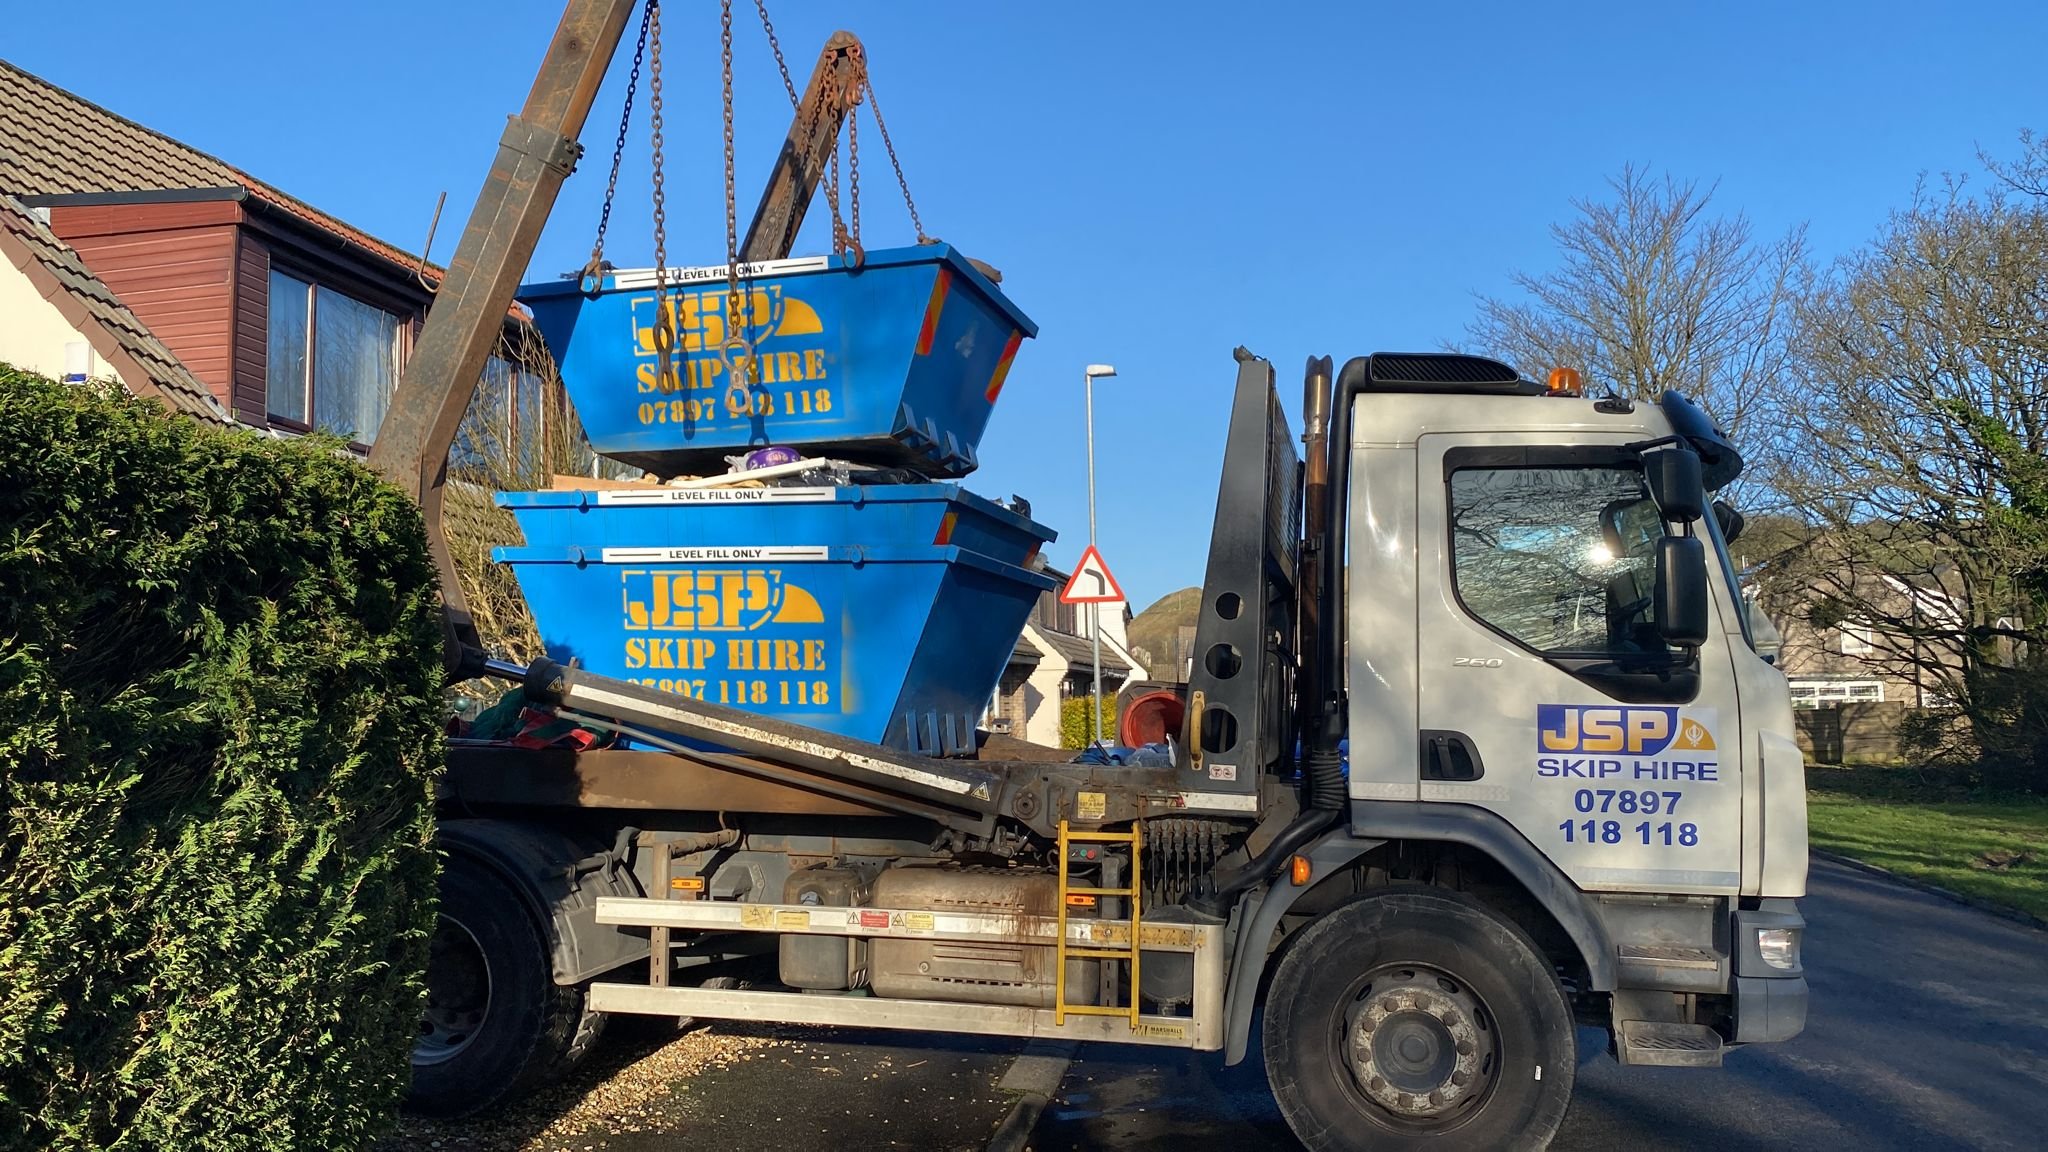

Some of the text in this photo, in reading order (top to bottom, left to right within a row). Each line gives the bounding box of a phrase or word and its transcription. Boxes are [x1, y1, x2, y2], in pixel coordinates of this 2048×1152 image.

[678, 269, 710, 281] LEVEL
[738, 265, 765, 275] ONLY
[638, 292, 770, 351] JSP
[638, 397, 716, 425] 07897
[784, 389, 832, 415] 118
[671, 490, 764, 500] LEVEL FILL ONLY
[669, 549, 762, 559] LEVEL FILL ONLY
[629, 575, 769, 627] JSP
[625, 638, 826, 671] SKIP HIRE
[1453, 657, 1503, 669] 260
[719, 680, 768, 704] 118
[779, 681, 829, 705] 118
[1542, 708, 1669, 753] JSP
[1537, 758, 1718, 781] SKIP HIRE
[1574, 788, 1682, 815] 07897
[1559, 819, 1699, 847] 118 118
